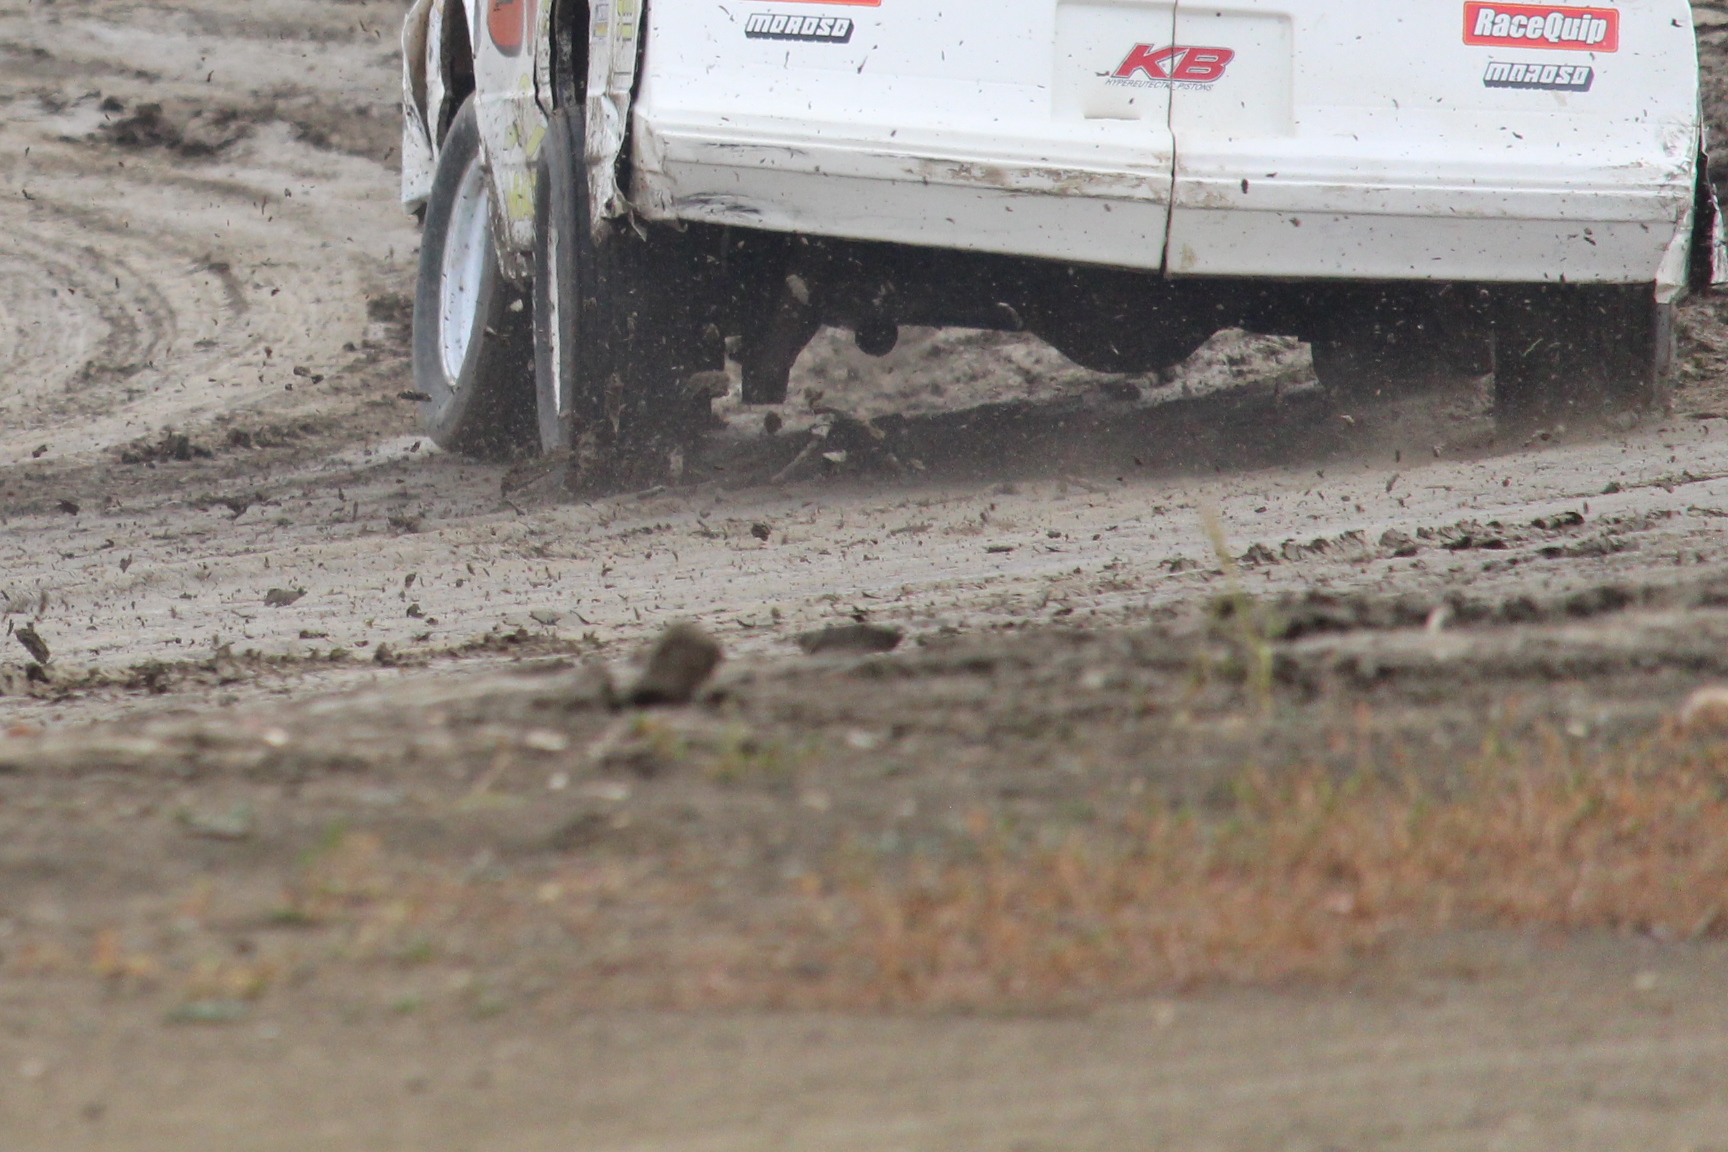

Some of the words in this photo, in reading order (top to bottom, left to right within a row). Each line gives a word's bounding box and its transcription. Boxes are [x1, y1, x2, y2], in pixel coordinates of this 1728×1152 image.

[745, 13, 854, 42] MOROSO
[1474, 8, 1608, 44] RaceQuip
[1111, 42, 1235, 83] KB
[1177, 82, 1214, 92] PISTONS
